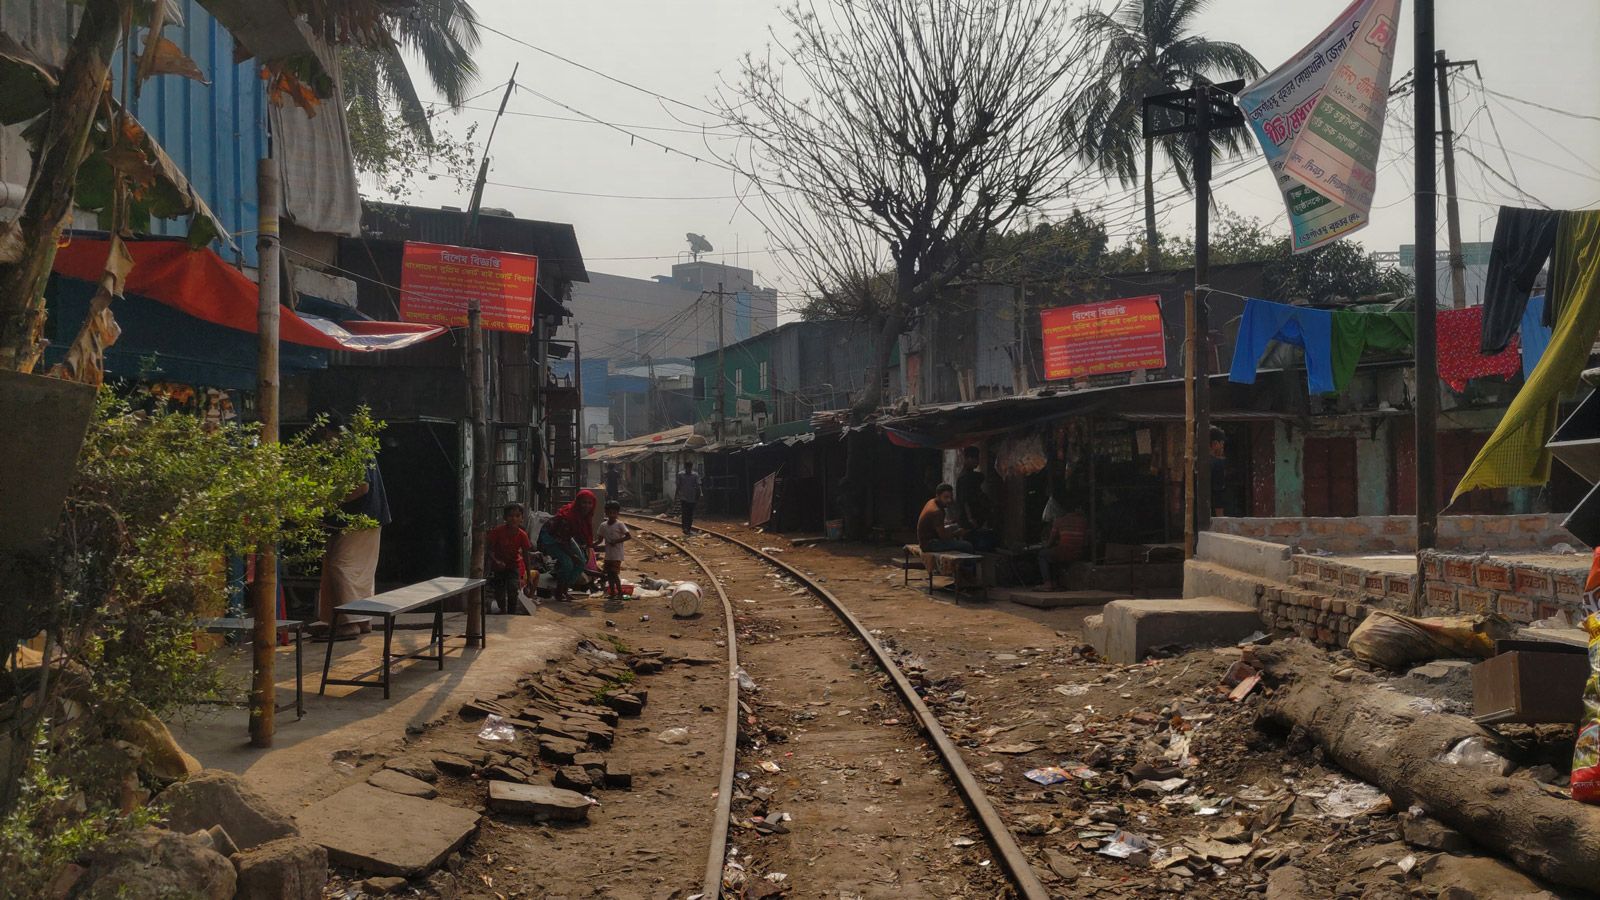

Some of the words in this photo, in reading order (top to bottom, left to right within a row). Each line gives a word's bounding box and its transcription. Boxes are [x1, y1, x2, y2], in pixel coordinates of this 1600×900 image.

[1294, 51, 1327, 88] নোয়াখালী
[1325, 38, 1347, 63] জেলা
[441, 251, 467, 264] বিশেষ
[471, 254, 500, 268] বিজ্ঞপ্তি
[1072, 309, 1096, 320] বিশেষ
[1098, 304, 1126, 317] বিজ্ঞপ্তি
